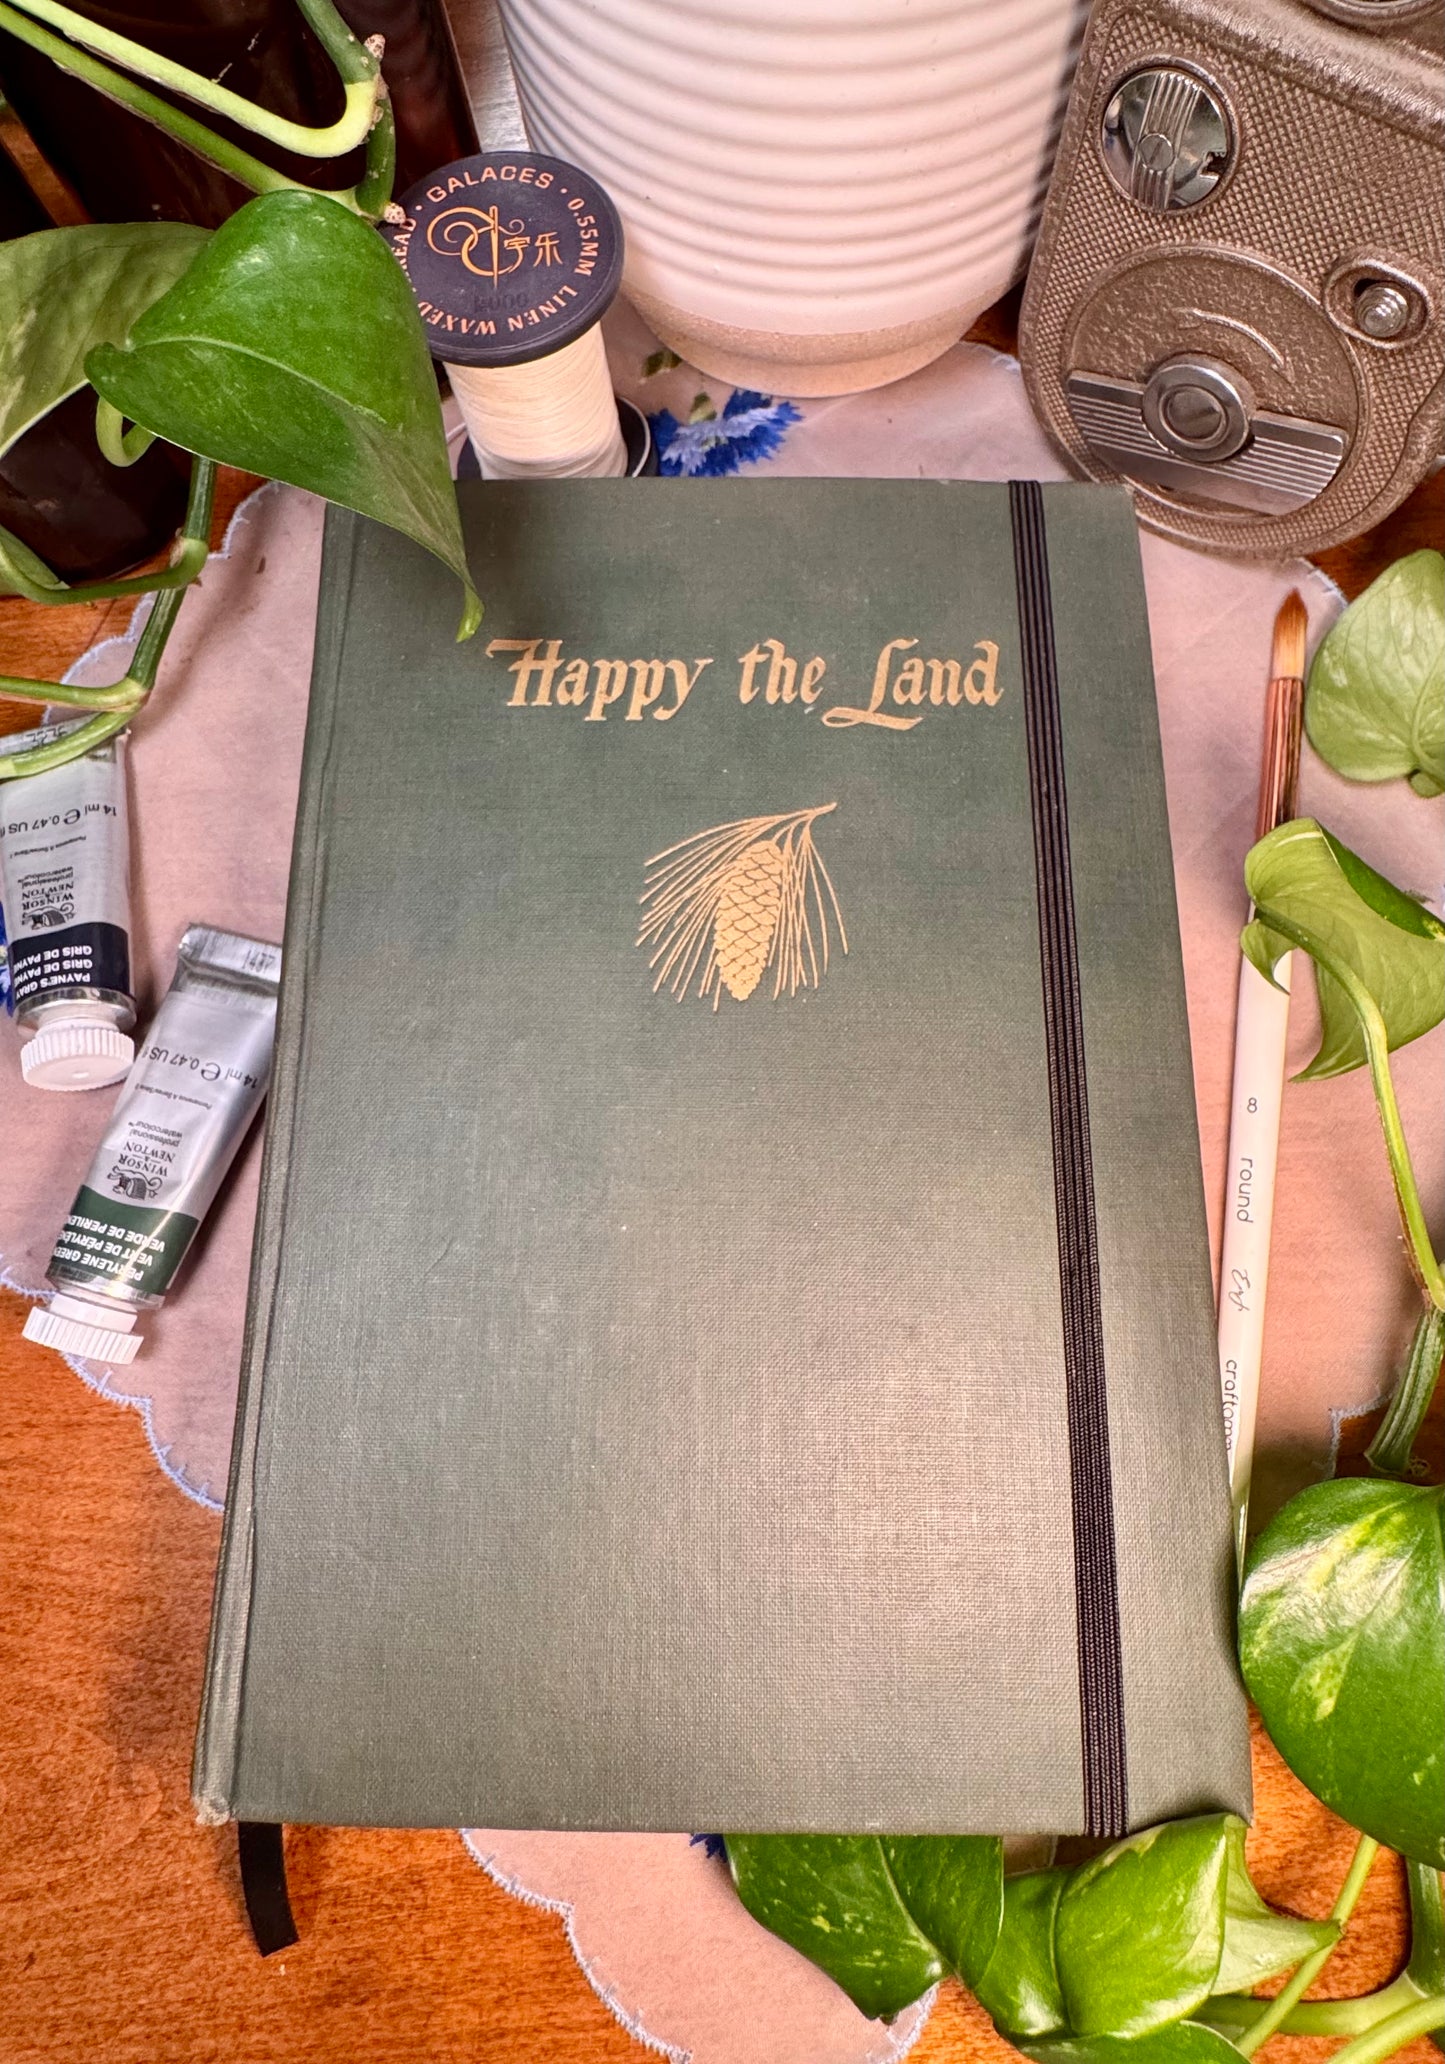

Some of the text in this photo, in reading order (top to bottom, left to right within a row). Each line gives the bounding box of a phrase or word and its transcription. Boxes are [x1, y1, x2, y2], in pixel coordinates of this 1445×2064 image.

[426, 165, 554, 204] GALACES
[567, 197, 600, 276] 0.55MM
[508, 285, 578, 332] LINEN
[418, 301, 497, 335] WAXED
[485, 638, 1005, 731] Happy the Land
[84, 803, 100, 816] ml
[103, 803, 117, 817] 14
[8, 821, 28, 834] US
[32, 814, 60, 830] 0.47
[22, 881, 74, 900] NEWTON
[22, 892, 74, 910] WINSOR
[43, 948, 60, 960] DE
[43, 961, 60, 974] DE
[62, 958, 93, 970] GRIS
[15, 972, 91, 1000] PAYNE'S GRAY
[149, 1046, 169, 1063] US
[170, 1053, 200, 1070] 0.47
[224, 1067, 243, 1081] ml
[243, 1074, 258, 1089] 14
[1246, 1096, 1258, 1114] 8
[129, 1129, 180, 1147] professional
[123, 1141, 176, 1163] NEWTON
[118, 1153, 168, 1177] WINSOR
[1236, 1157, 1254, 1223] round
[107, 1225, 128, 1239] DE
[124, 1229, 165, 1252] VERDE
[102, 1241, 122, 1257] DE
